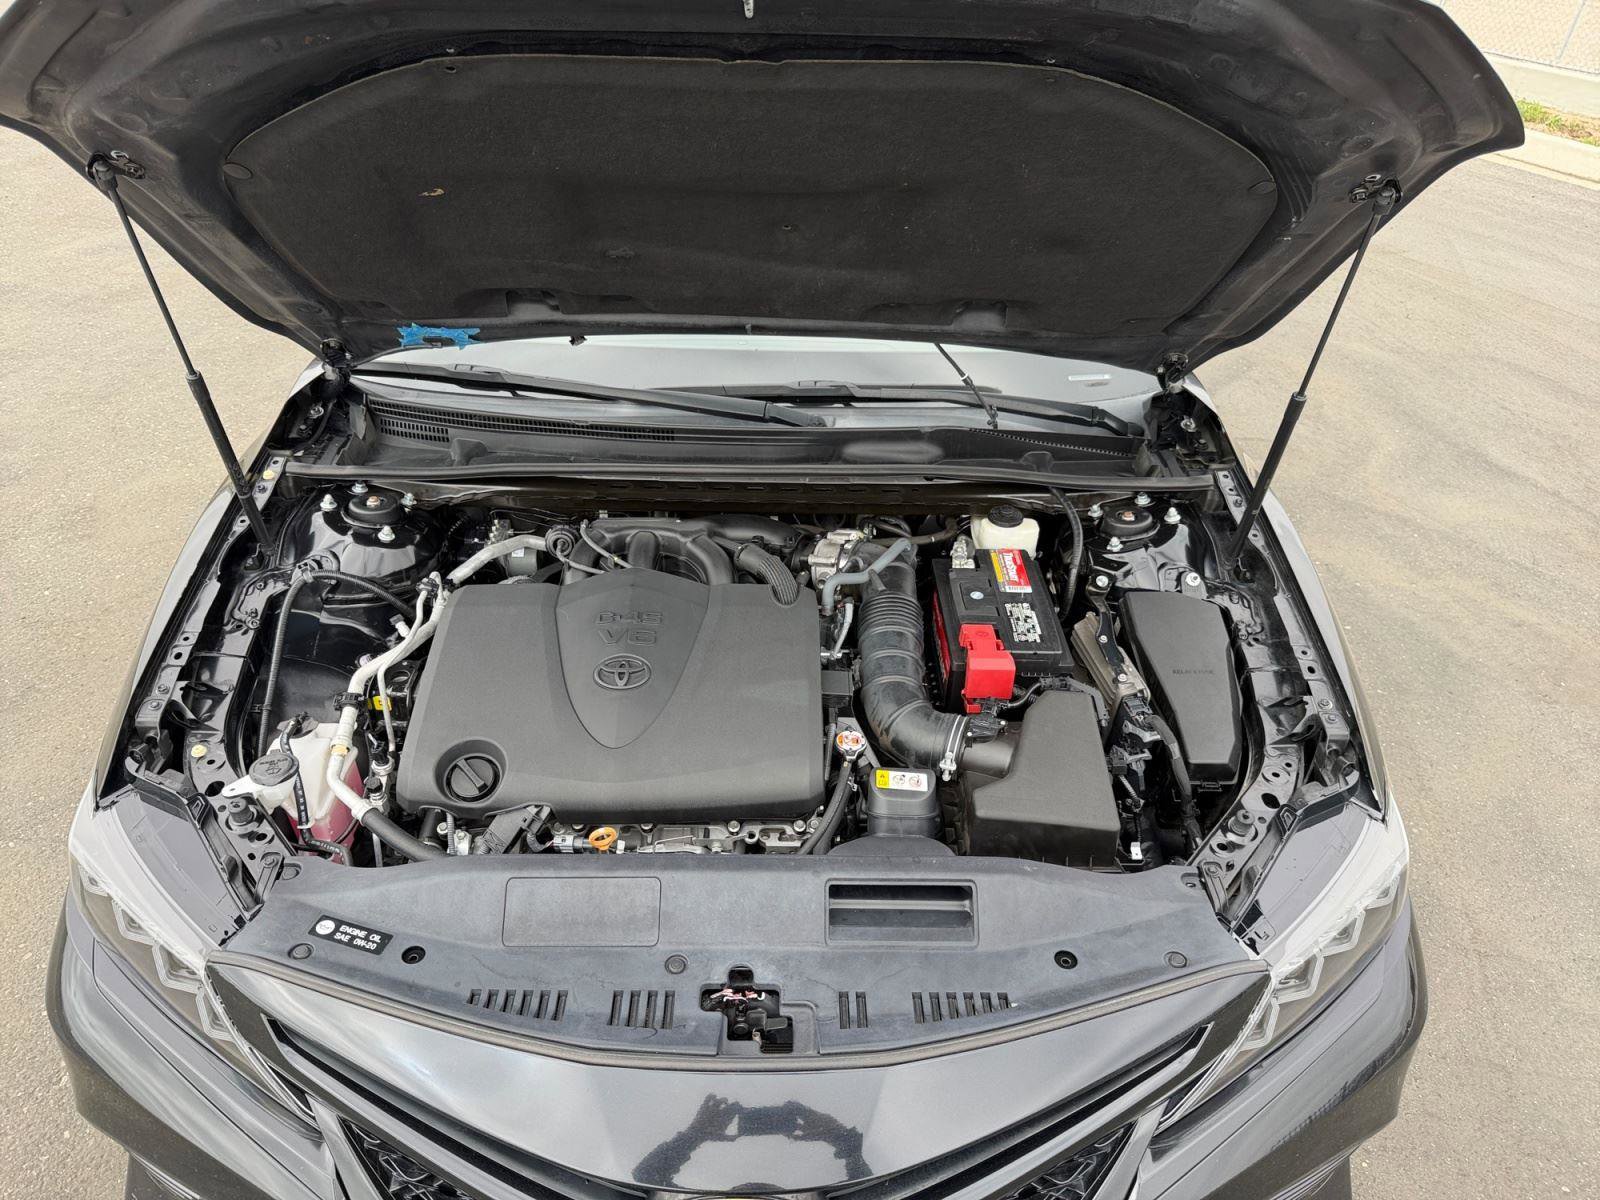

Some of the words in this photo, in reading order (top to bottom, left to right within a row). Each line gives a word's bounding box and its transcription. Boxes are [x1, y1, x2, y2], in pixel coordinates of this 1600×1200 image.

[334, 932, 351, 943] SAE
[353, 938, 377, 950] 0W-20
[339, 925, 367, 938] ENGINE
[369, 933, 382, 943] OIL
